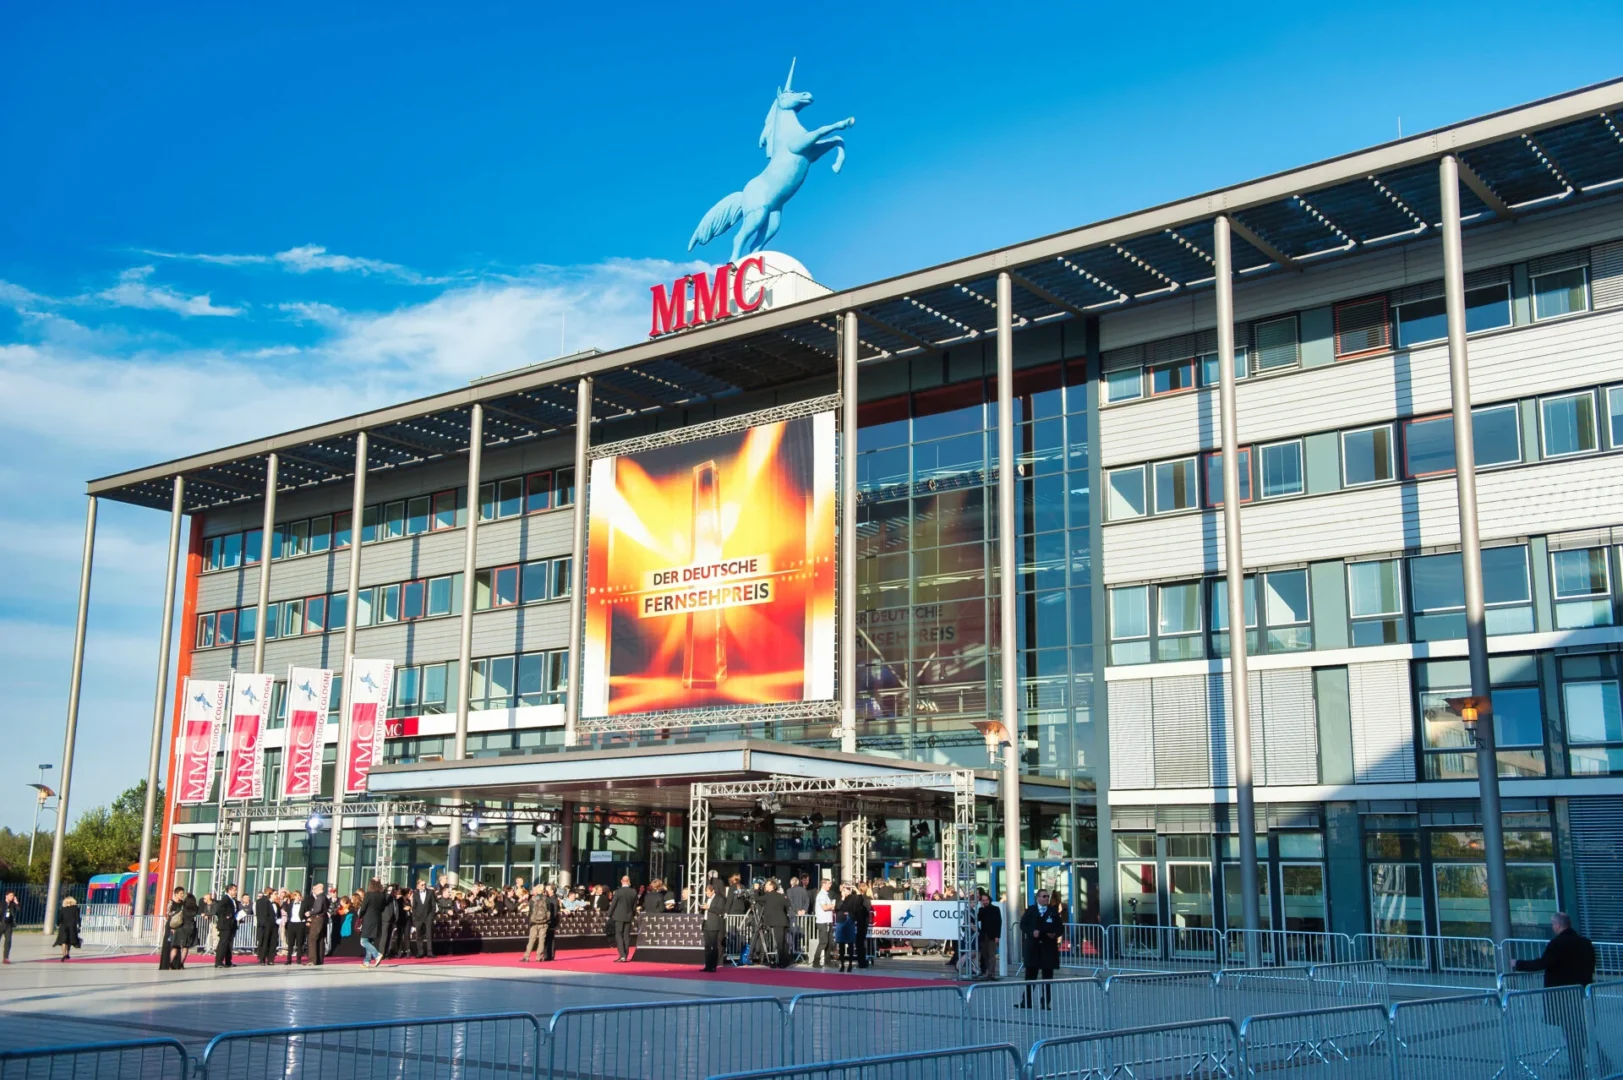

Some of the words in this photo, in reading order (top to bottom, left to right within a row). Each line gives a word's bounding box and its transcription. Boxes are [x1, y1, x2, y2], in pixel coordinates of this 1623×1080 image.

[649, 256, 765, 337] MMC
[653, 570, 679, 586] DER
[683, 558, 758, 583] DEUTSCHE
[644, 582, 770, 614] FERNSEHPREIS
[856, 626, 955, 648] RNSEHREIS
[214, 683, 225, 721] COLOGNE
[262, 676, 272, 715] COLOGNE
[320, 671, 331, 711] COLOGNE
[315, 713, 326, 749] STUDIOS
[376, 704, 386, 742] STUDIOS
[385, 723, 402, 737] MC
[187, 739, 210, 800] MMC
[235, 735, 258, 796] MMC
[292, 731, 314, 793] MMC
[354, 723, 374, 790] MMC
[374, 745, 381, 757] TV
[776, 837, 832, 850] EIANG
